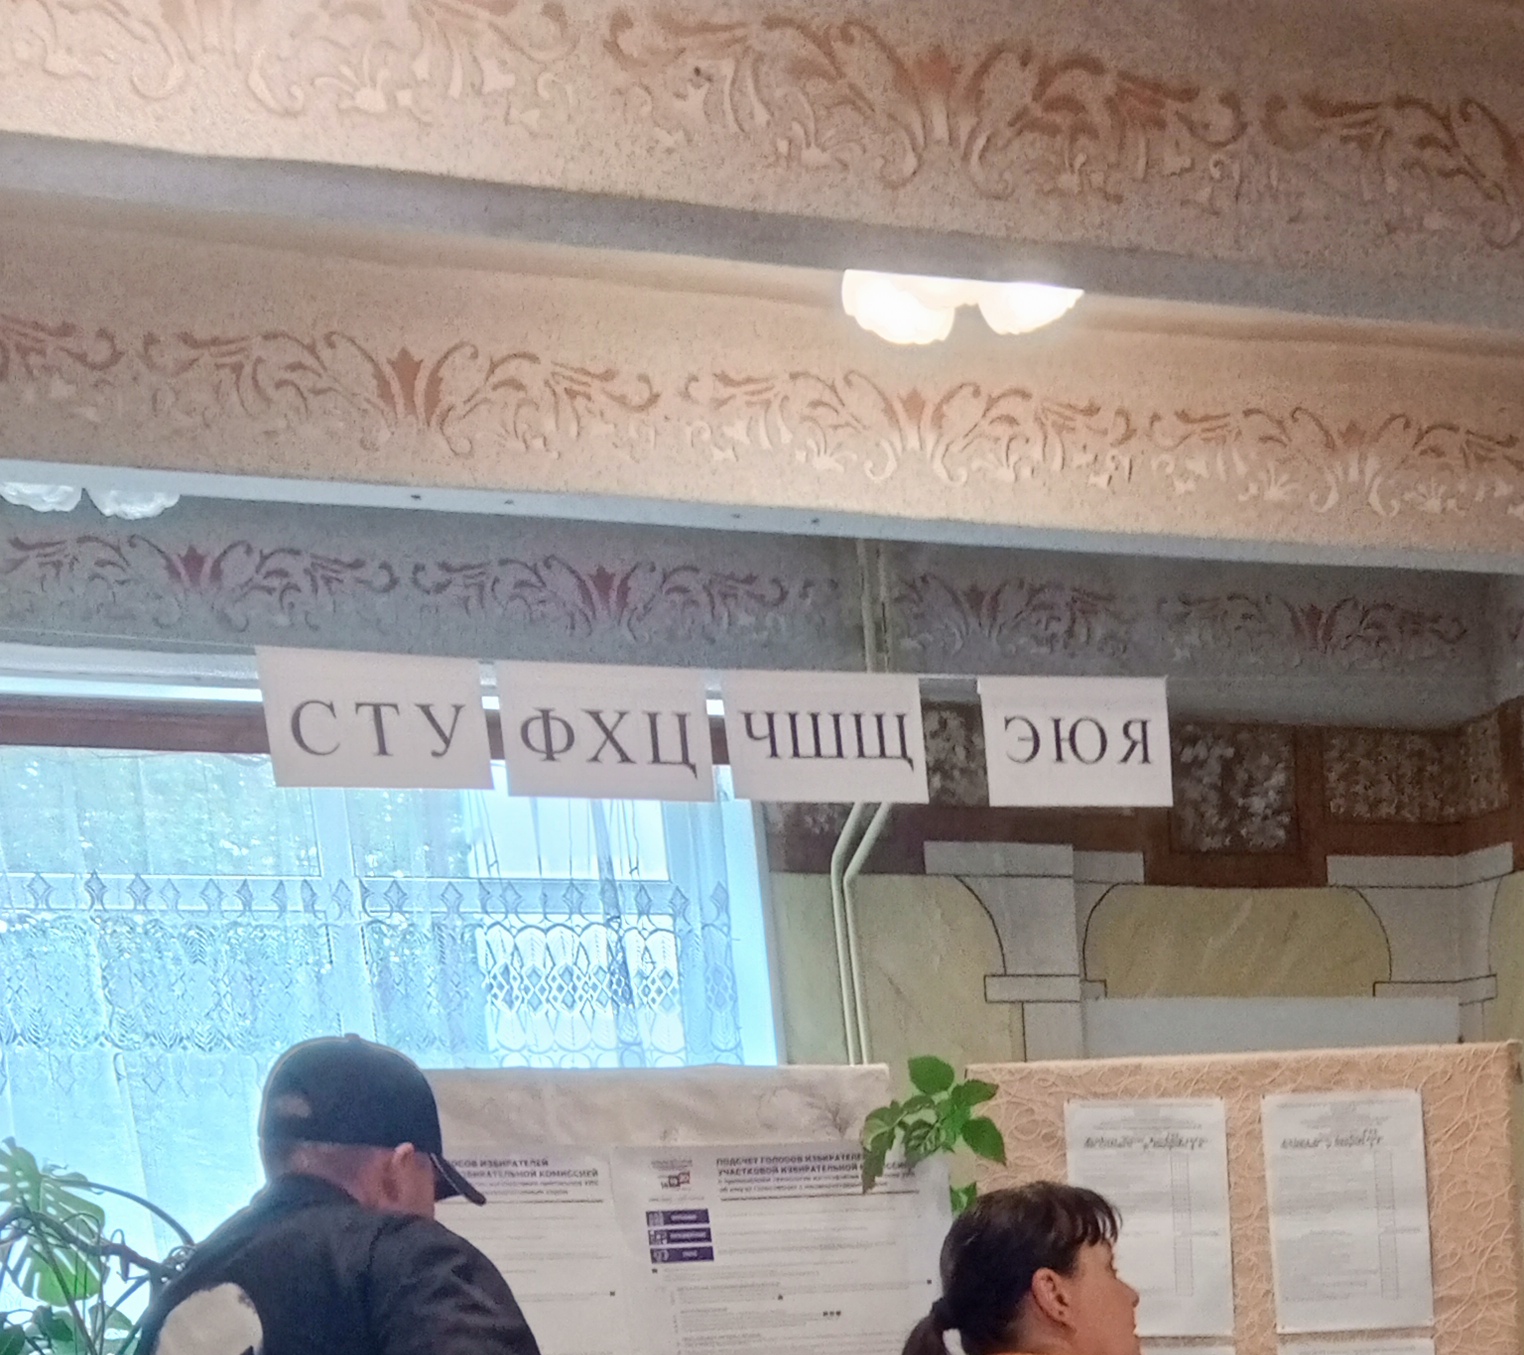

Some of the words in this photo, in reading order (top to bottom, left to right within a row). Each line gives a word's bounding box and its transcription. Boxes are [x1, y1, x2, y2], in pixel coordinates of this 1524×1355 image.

[289, 698, 467, 759] СТУ
[519, 706, 699, 780] ФХЦ
[738, 710, 915, 772] ЧШЩ
[1003, 715, 1153, 765] ЭЮЯ
